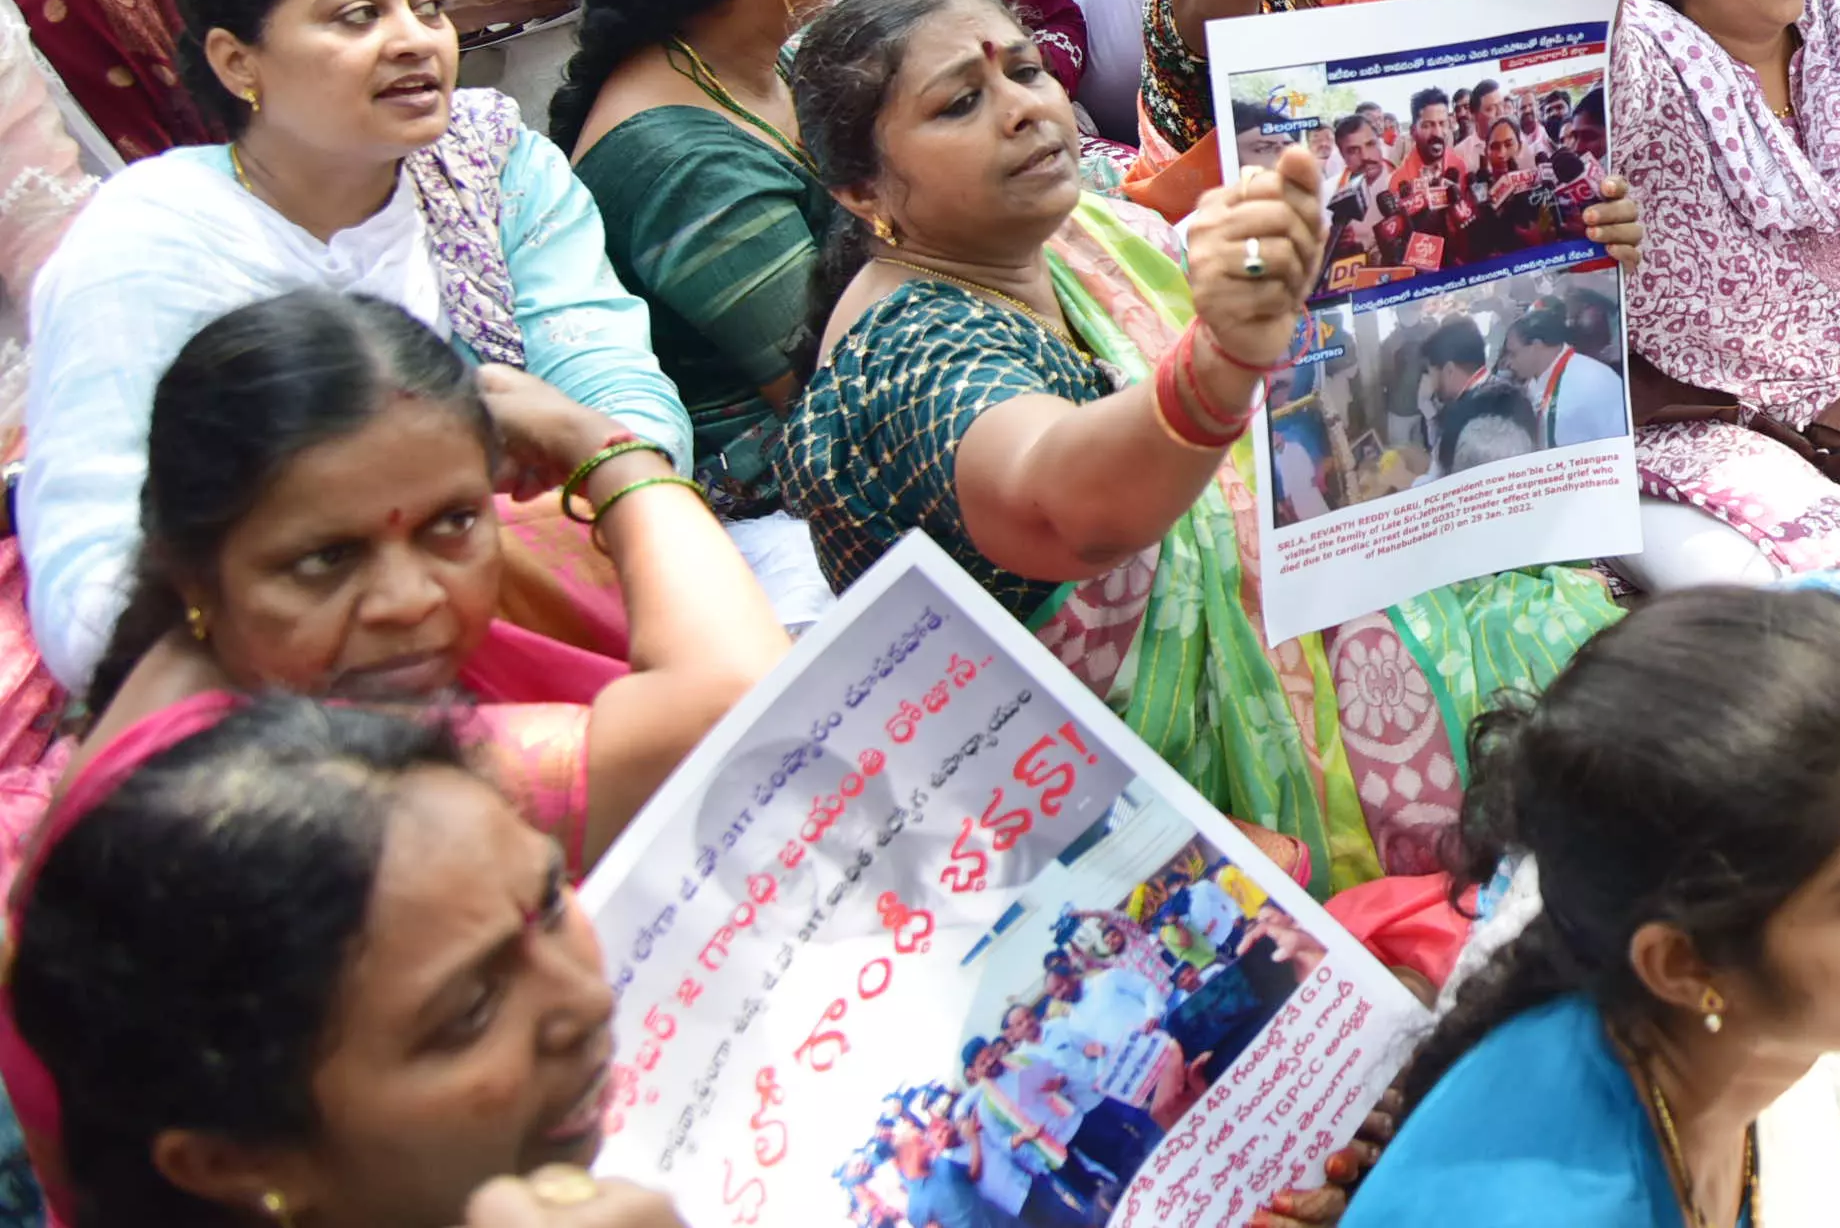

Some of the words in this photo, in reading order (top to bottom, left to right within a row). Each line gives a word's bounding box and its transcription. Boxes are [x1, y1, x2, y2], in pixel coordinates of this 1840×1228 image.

[1280, 562, 1301, 574] died
[1303, 556, 1320, 567] due
[1322, 551, 1332, 560] to
[1336, 540, 1370, 557] cardiac
[1373, 534, 1401, 546] arrest
[1402, 526, 1420, 536] due
[1421, 520, 1430, 529] to
[1463, 498, 1500, 515] transfer
[1503, 492, 1530, 504] effect
[1532, 490, 1542, 498] at
[1544, 477, 1620, 496] Sandhyathanda
[1285, 545, 1316, 561] visited
[1318, 539, 1334, 550] the
[1336, 530, 1366, 547] family
[1369, 524, 1380, 535] of
[1382, 520, 1401, 532] Late
[1458, 489, 1494, 505] Teacher
[1497, 484, 1514, 494] and
[1516, 474, 1564, 490] expressed
[1567, 470, 1590, 482] grief
[1592, 466, 1614, 476] who
[1310, 520, 1356, 540] REVANTH
[1358, 512, 1390, 526] REDDY
[1424, 494, 1441, 506] PCC
[1442, 480, 1484, 500] president
[1486, 475, 1506, 486] now
[1570, 453, 1619, 468] Telangana
[1364, 550, 1375, 560] of
[1378, 528, 1438, 555] Mahabubabad
[1440, 522, 1456, 535] (D)
[1457, 518, 1470, 528] on
[1484, 508, 1505, 520] Jan.
[699, 873, 778, 971] గాంధీ
[779, 747, 888, 870] జయంతి
[795, 890, 934, 1072] గాంధీ
[939, 720, 1100, 894] భవన్!
